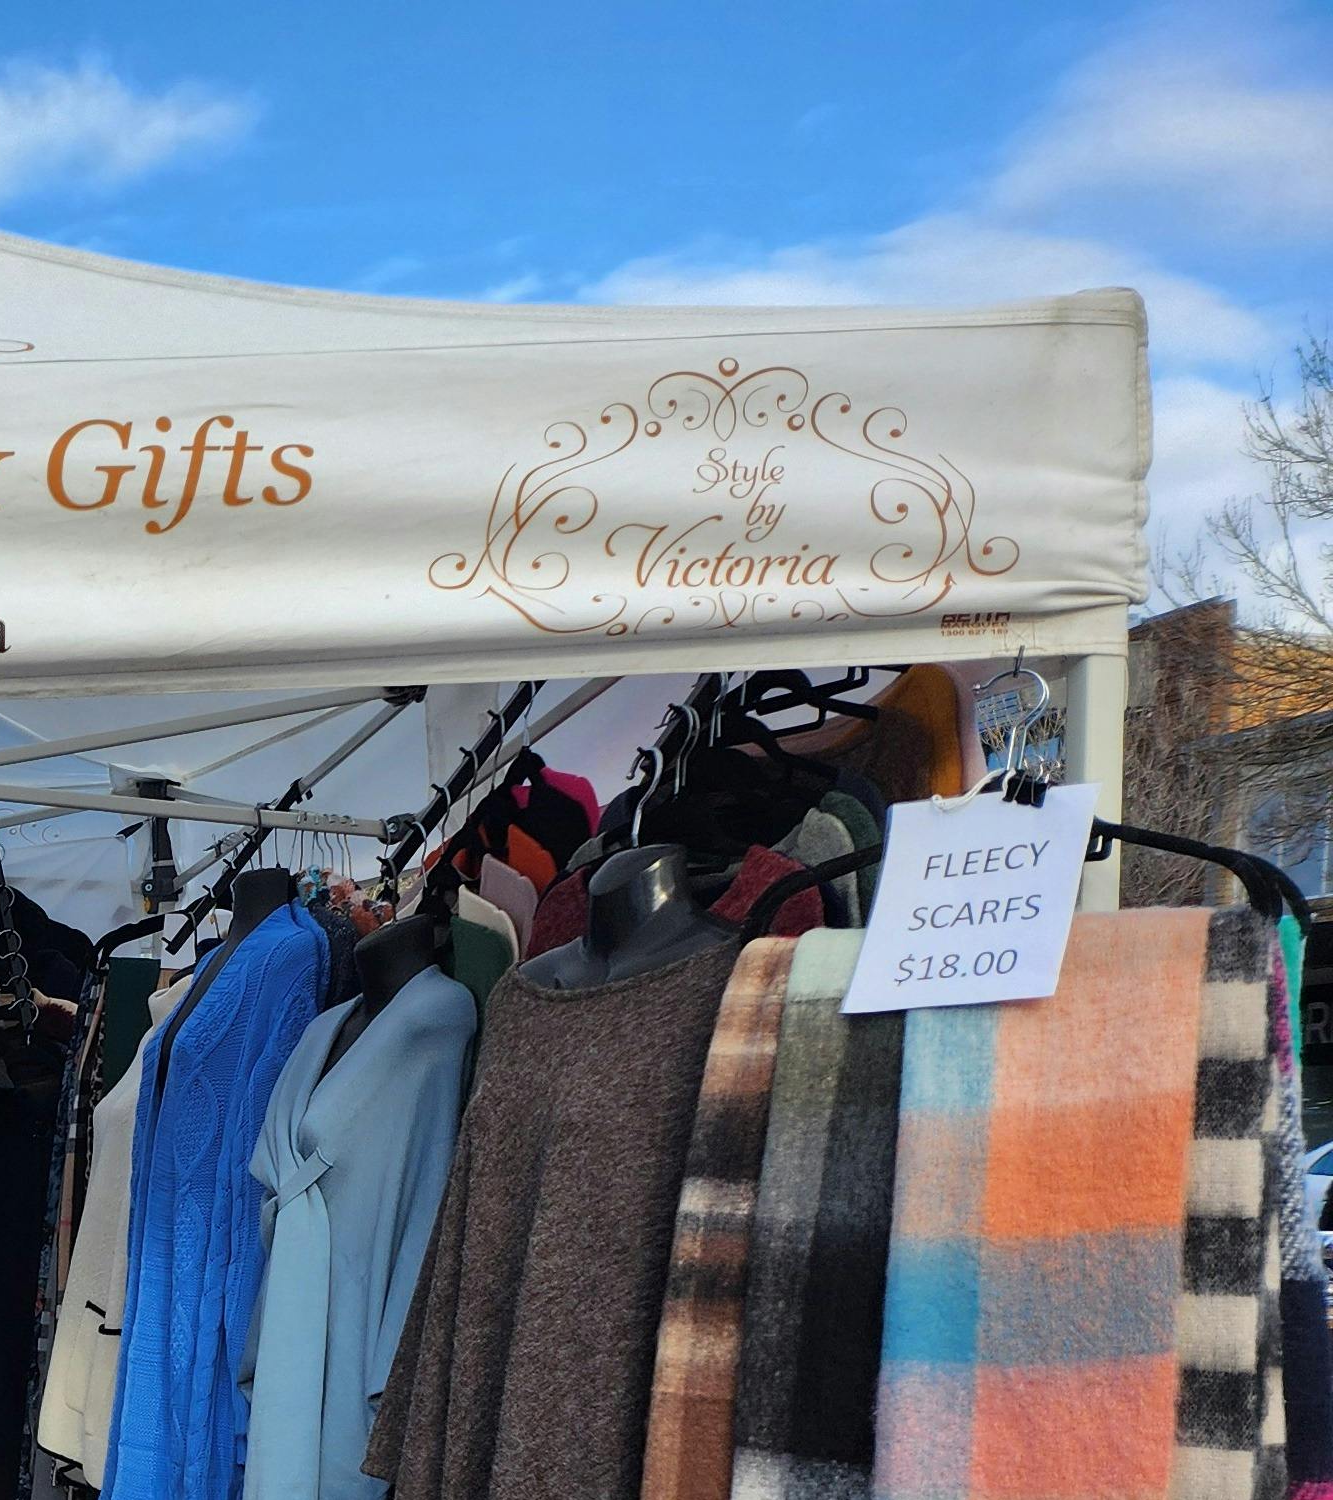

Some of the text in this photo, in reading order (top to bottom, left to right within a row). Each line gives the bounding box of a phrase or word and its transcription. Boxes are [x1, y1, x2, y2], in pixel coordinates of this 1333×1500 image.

[47, 414, 315, 534] Gifts
[692, 445, 785, 498] Style
[746, 480, 787, 539] by
[605, 515, 838, 590] Victoria
[923, 840, 1050, 881] FLEECY
[908, 894, 1042, 932] SCARFS
[894, 949, 1018, 986] $18.00
